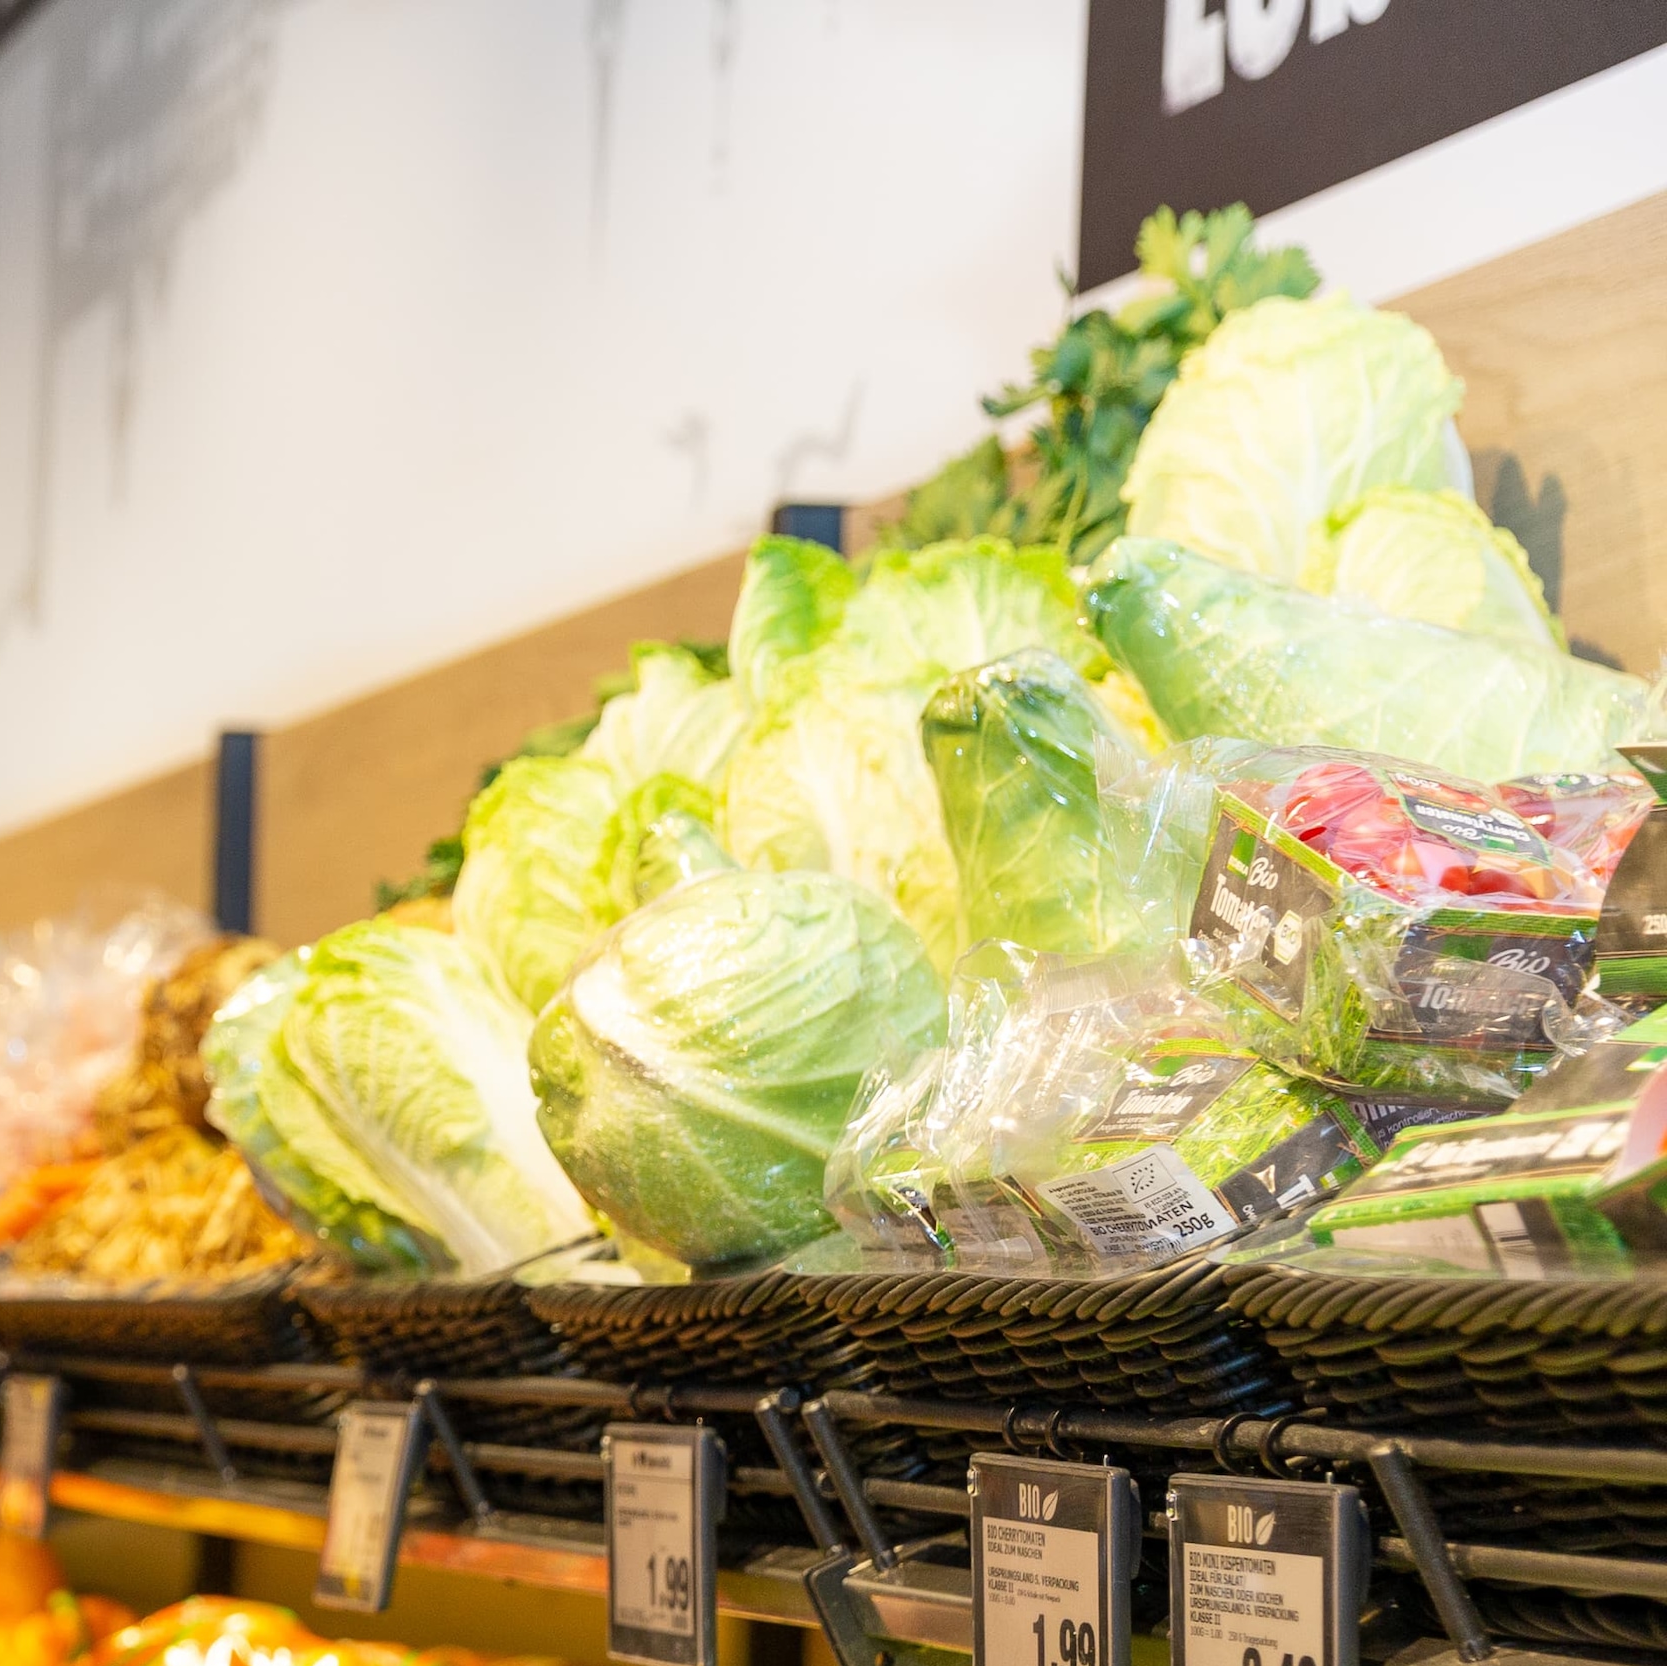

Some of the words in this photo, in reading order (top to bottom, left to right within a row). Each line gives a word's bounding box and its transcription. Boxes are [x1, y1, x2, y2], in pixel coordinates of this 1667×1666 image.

[1414, 803, 1531, 842] Cherrytomaten
[1440, 824, 1484, 842] Bio
[1247, 856, 1288, 890] Bio
[1486, 948, 1551, 974] Bio
[1169, 1062, 1216, 1088] Bio
[1114, 1089, 1193, 1115] Tomaten
[1172, 1212, 1215, 1238] 250g
[1019, 1483, 1040, 1519] BIO
[987, 1524, 997, 1539] BIO
[998, 1526, 1046, 1546] CHERRYTOMATEN
[1227, 1505, 1253, 1543] BIO
[987, 1541, 1003, 1554] IDEAL
[1004, 1544, 1016, 1556] ZUM
[1017, 1546, 1043, 1560] NASCHEN
[1189, 1551, 1201, 1567] BIO
[1202, 1553, 1219, 1569] MINI
[1220, 1555, 1276, 1576] RISPENTOMATEN
[647, 1553, 689, 1611] 1.99
[987, 1566, 1034, 1584] URSPRUNGSLAND
[1041, 1575, 1079, 1592] VERPACKUNG
[988, 1579, 1007, 1591] KLASSE
[1189, 1569, 1208, 1582] IDEAL
[1210, 1570, 1222, 1585] FÜR
[1189, 1583, 1204, 1595] ZUM
[1205, 1584, 1234, 1599] NASCHEN
[1236, 1589, 1254, 1602] ODER
[1255, 1591, 1284, 1606] KOCHEN
[1189, 1597, 1245, 1615] URSPRUNGSLAND
[1254, 1605, 1299, 1622] VERPACKUNG
[1190, 1610, 1213, 1624] KLASSE
[1214, 1613, 1221, 1626] II
